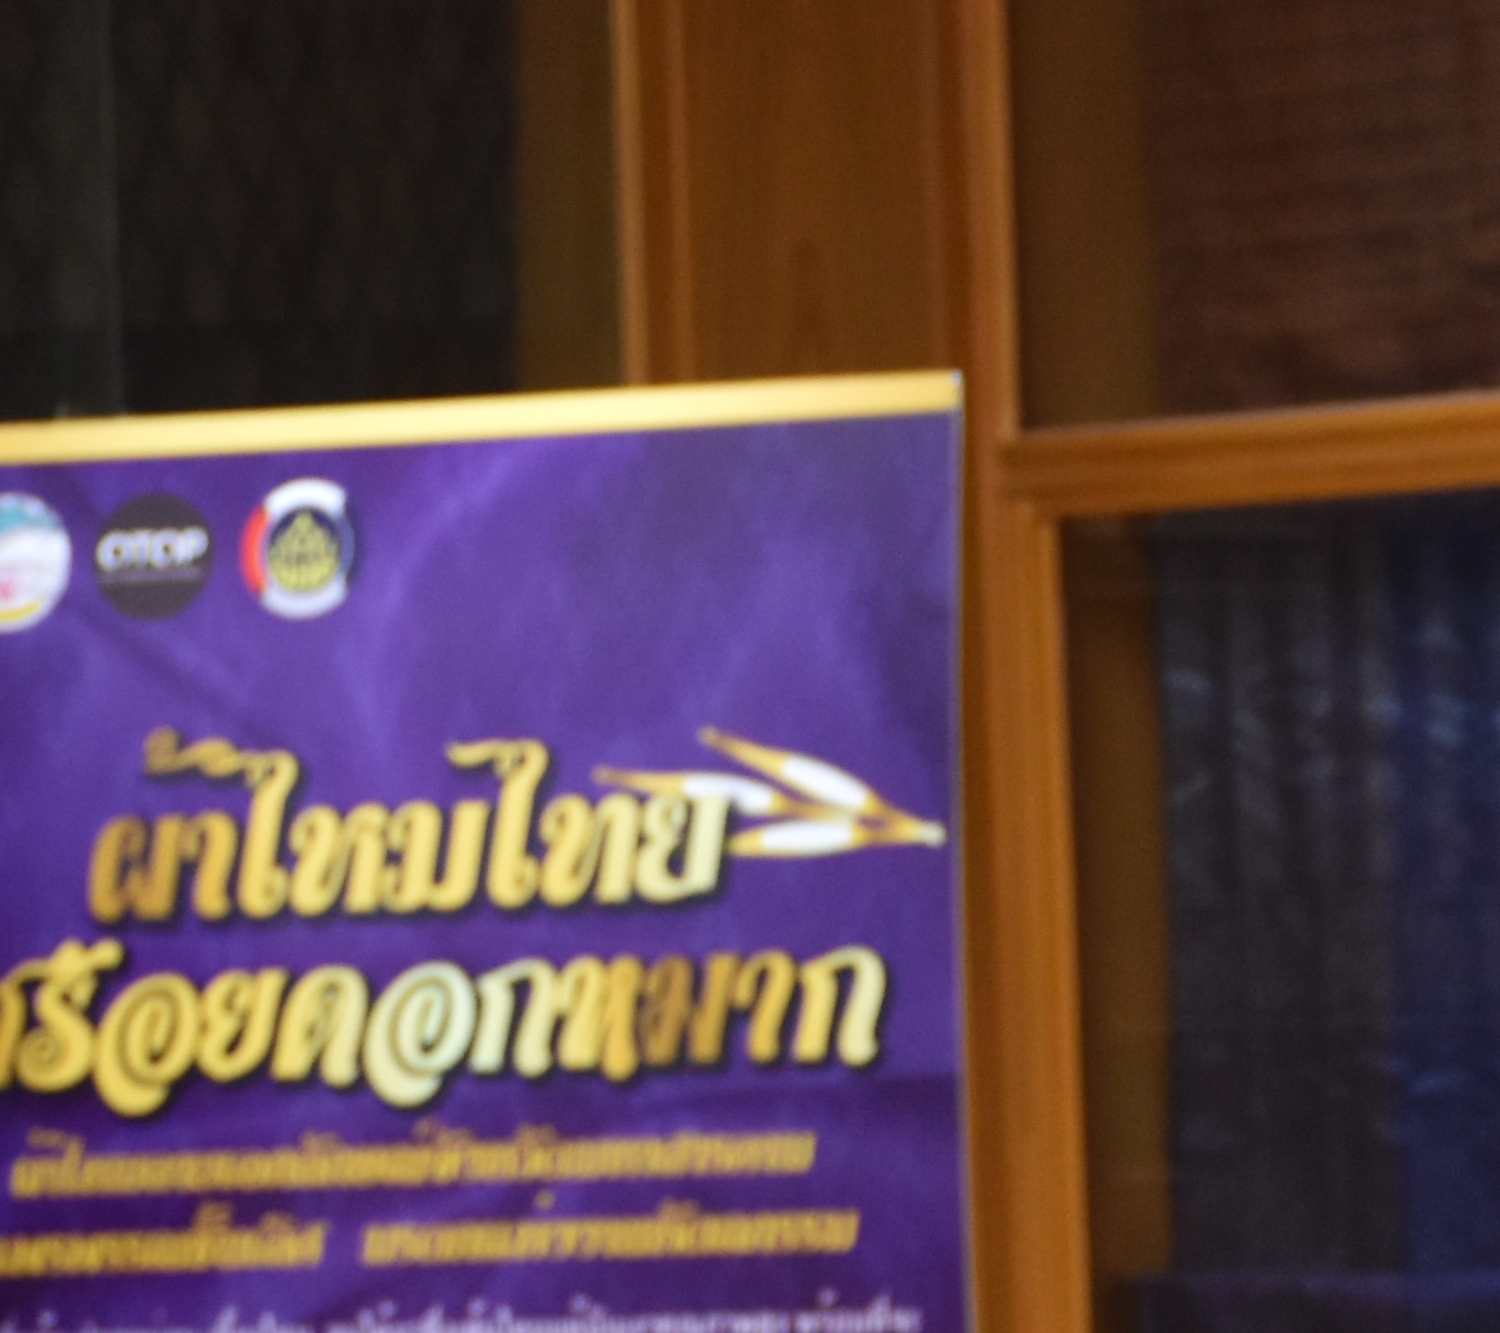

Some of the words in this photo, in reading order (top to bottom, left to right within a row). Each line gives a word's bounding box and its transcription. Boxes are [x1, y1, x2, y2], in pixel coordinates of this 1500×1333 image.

[96, 526, 209, 573] OTOP
[88, 726, 730, 921] ผ้าไหมไทย
